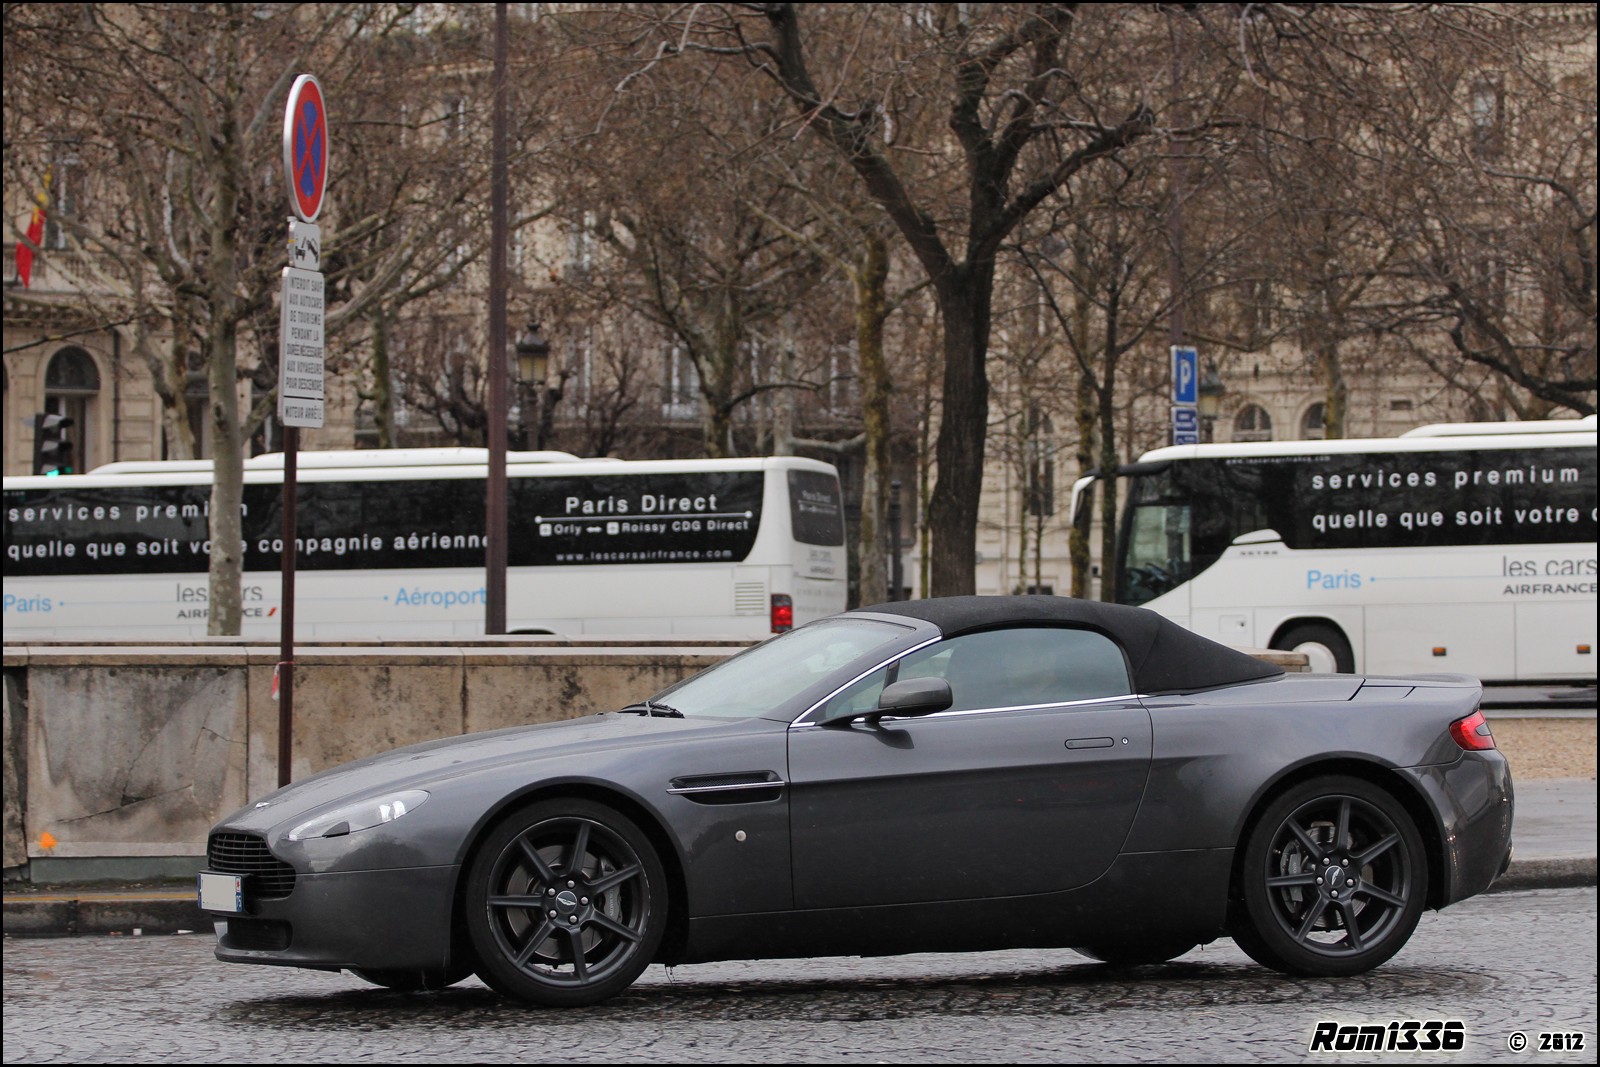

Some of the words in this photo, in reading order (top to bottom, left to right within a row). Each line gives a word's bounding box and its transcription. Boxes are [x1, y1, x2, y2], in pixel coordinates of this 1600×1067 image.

[289, 293, 298, 305] AUX
[290, 310, 297, 322] DE
[298, 311, 321, 325] TOURISME
[291, 327, 312, 340] PENDANT
[285, 406, 303, 418] MOTEUR
[1312, 469, 1437, 489] services
[1455, 465, 1579, 489] premium
[565, 496, 628, 513] Paris
[641, 494, 717, 511] Direct
[8, 504, 120, 522] services
[1312, 509, 1388, 533] quelle
[1400, 511, 1443, 530] que
[1456, 506, 1503, 525] soit
[1514, 505, 1580, 523] votre
[554, 524, 582, 535] Orly
[622, 521, 666, 533] Roissy
[671, 520, 702, 531] CDG
[707, 518, 749, 530] Direct
[8, 540, 76, 561] quelle
[86, 542, 126, 559] que
[136, 538, 179, 555] soit
[1503, 555, 1537, 577] les
[1545, 559, 1597, 576] cars
[1307, 568, 1362, 590] Paris
[177, 584, 208, 602] les
[394, 587, 487, 609] Aéroport
[1503, 583, 1597, 595] AIRFRANCE
[4, 594, 52, 612] Paris
